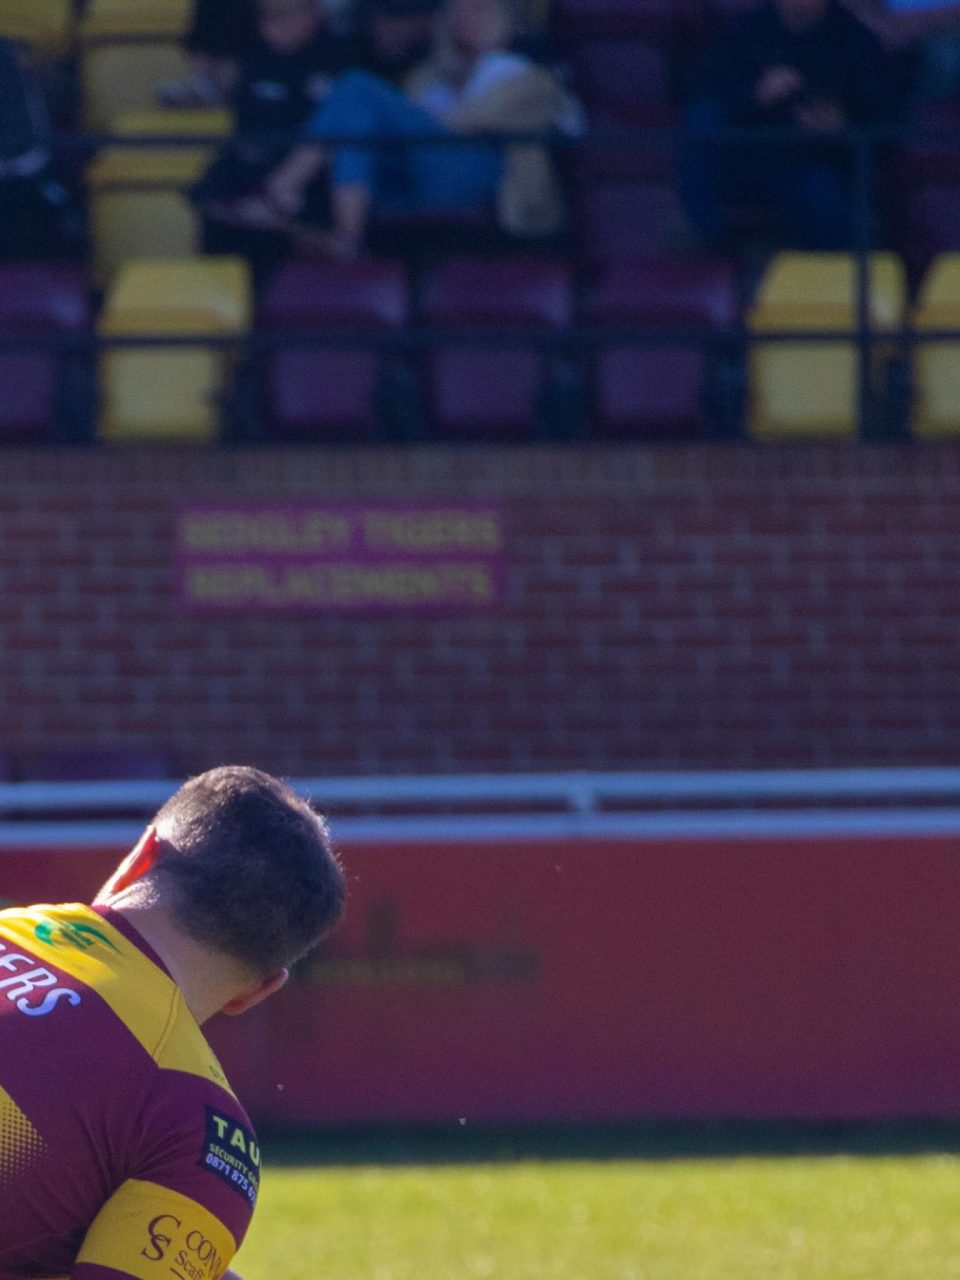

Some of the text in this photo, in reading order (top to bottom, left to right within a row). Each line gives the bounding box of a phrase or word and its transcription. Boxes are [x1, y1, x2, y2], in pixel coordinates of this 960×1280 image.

[205, 1152, 231, 1175] 0871
[231, 1169, 248, 1192] 875
[208, 1143, 249, 1174] SECURITY
